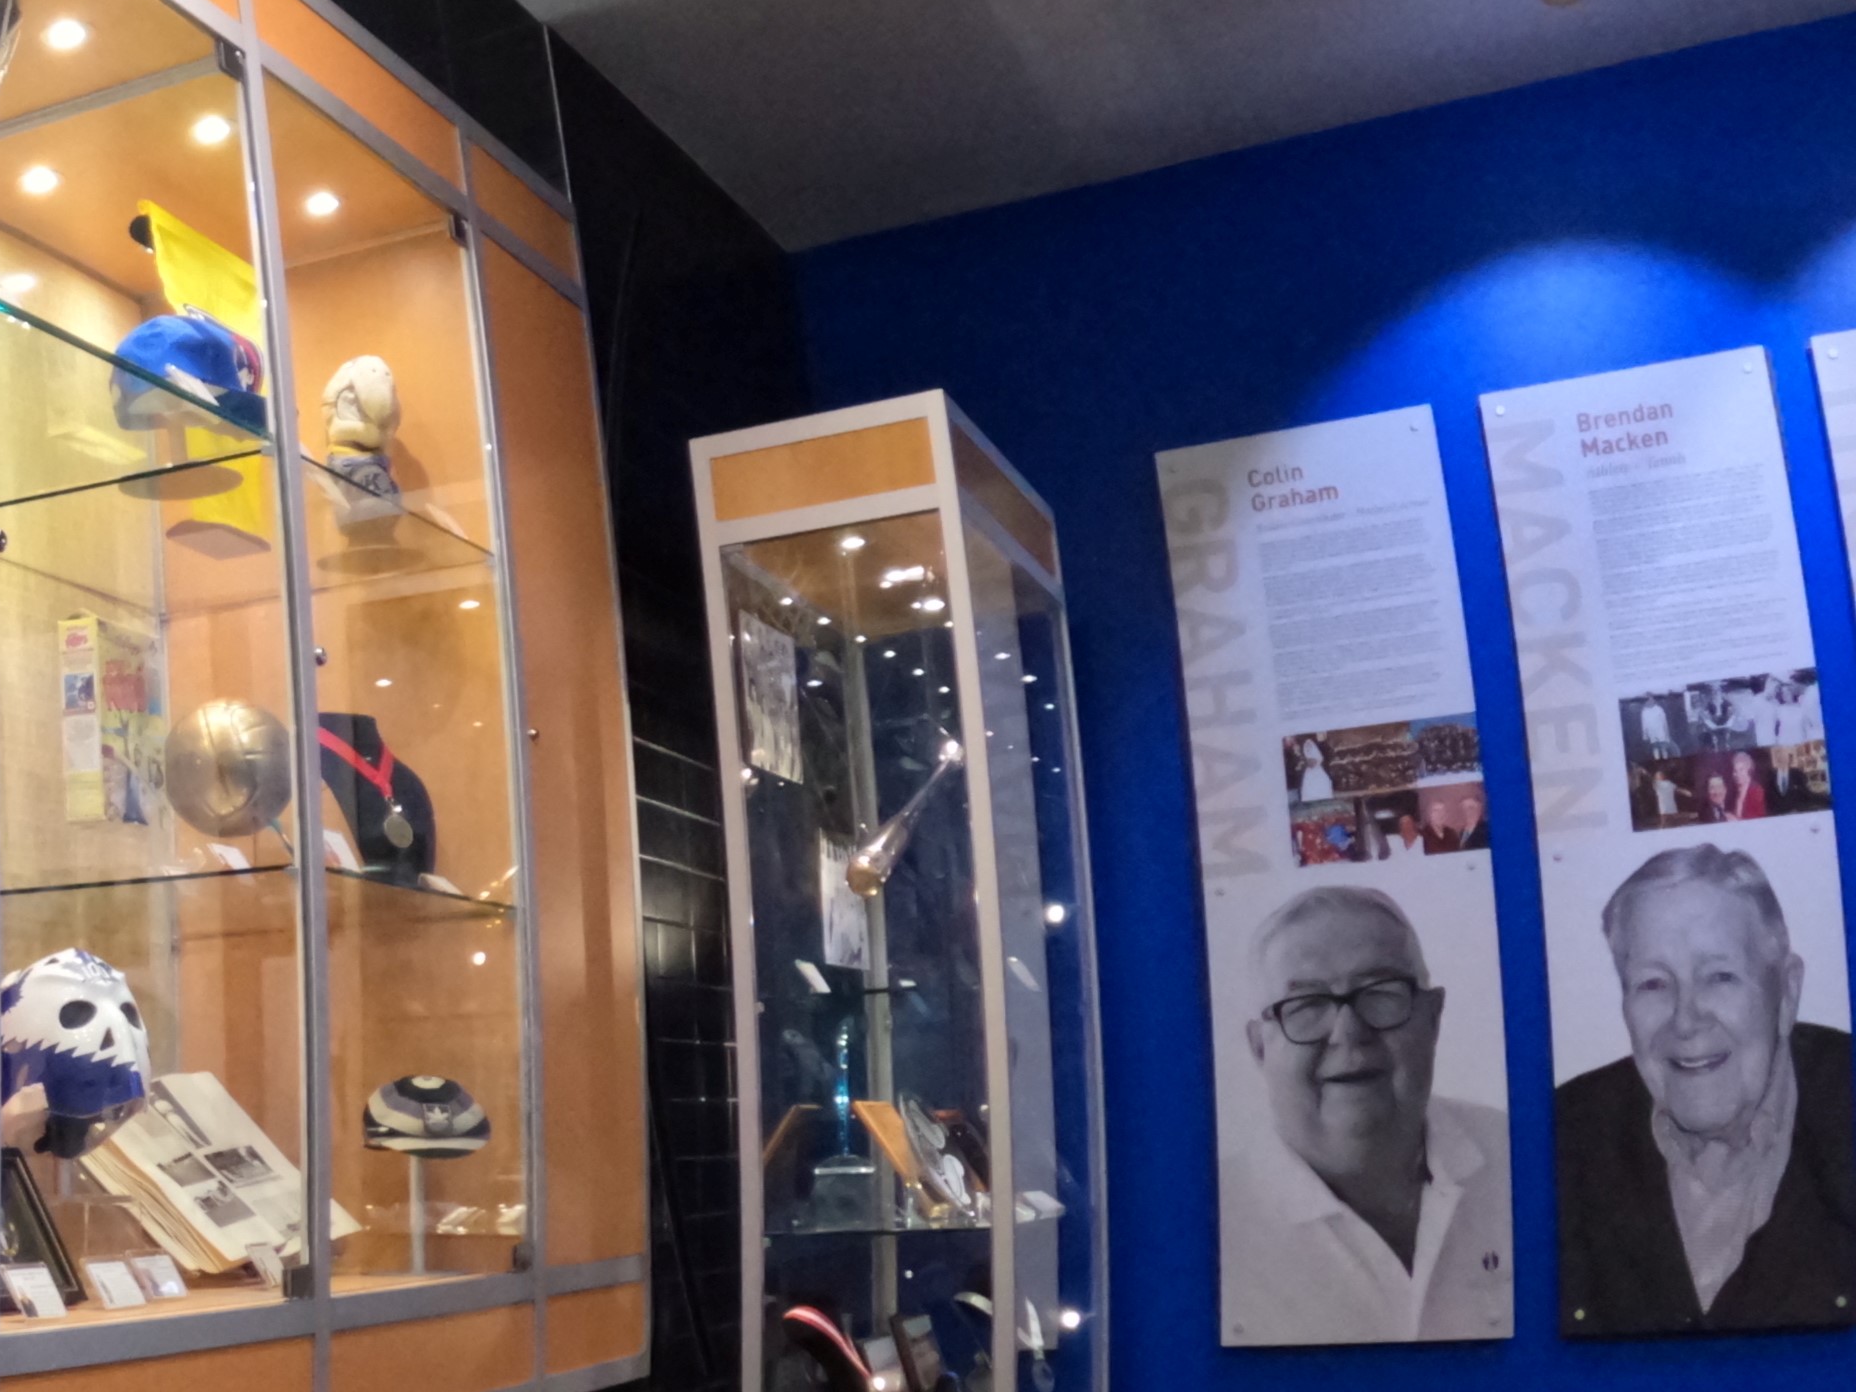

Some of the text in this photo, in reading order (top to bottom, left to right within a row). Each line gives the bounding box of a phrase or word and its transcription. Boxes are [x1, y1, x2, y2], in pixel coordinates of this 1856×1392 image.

[1576, 401, 1674, 433] Brendan
[1580, 429, 1669, 458] Macken
[1247, 464, 1304, 488] Colin
[1250, 483, 1340, 512] Graham
[1484, 415, 1614, 837] MACKEN
[1161, 474, 1274, 880] GRAHAM
